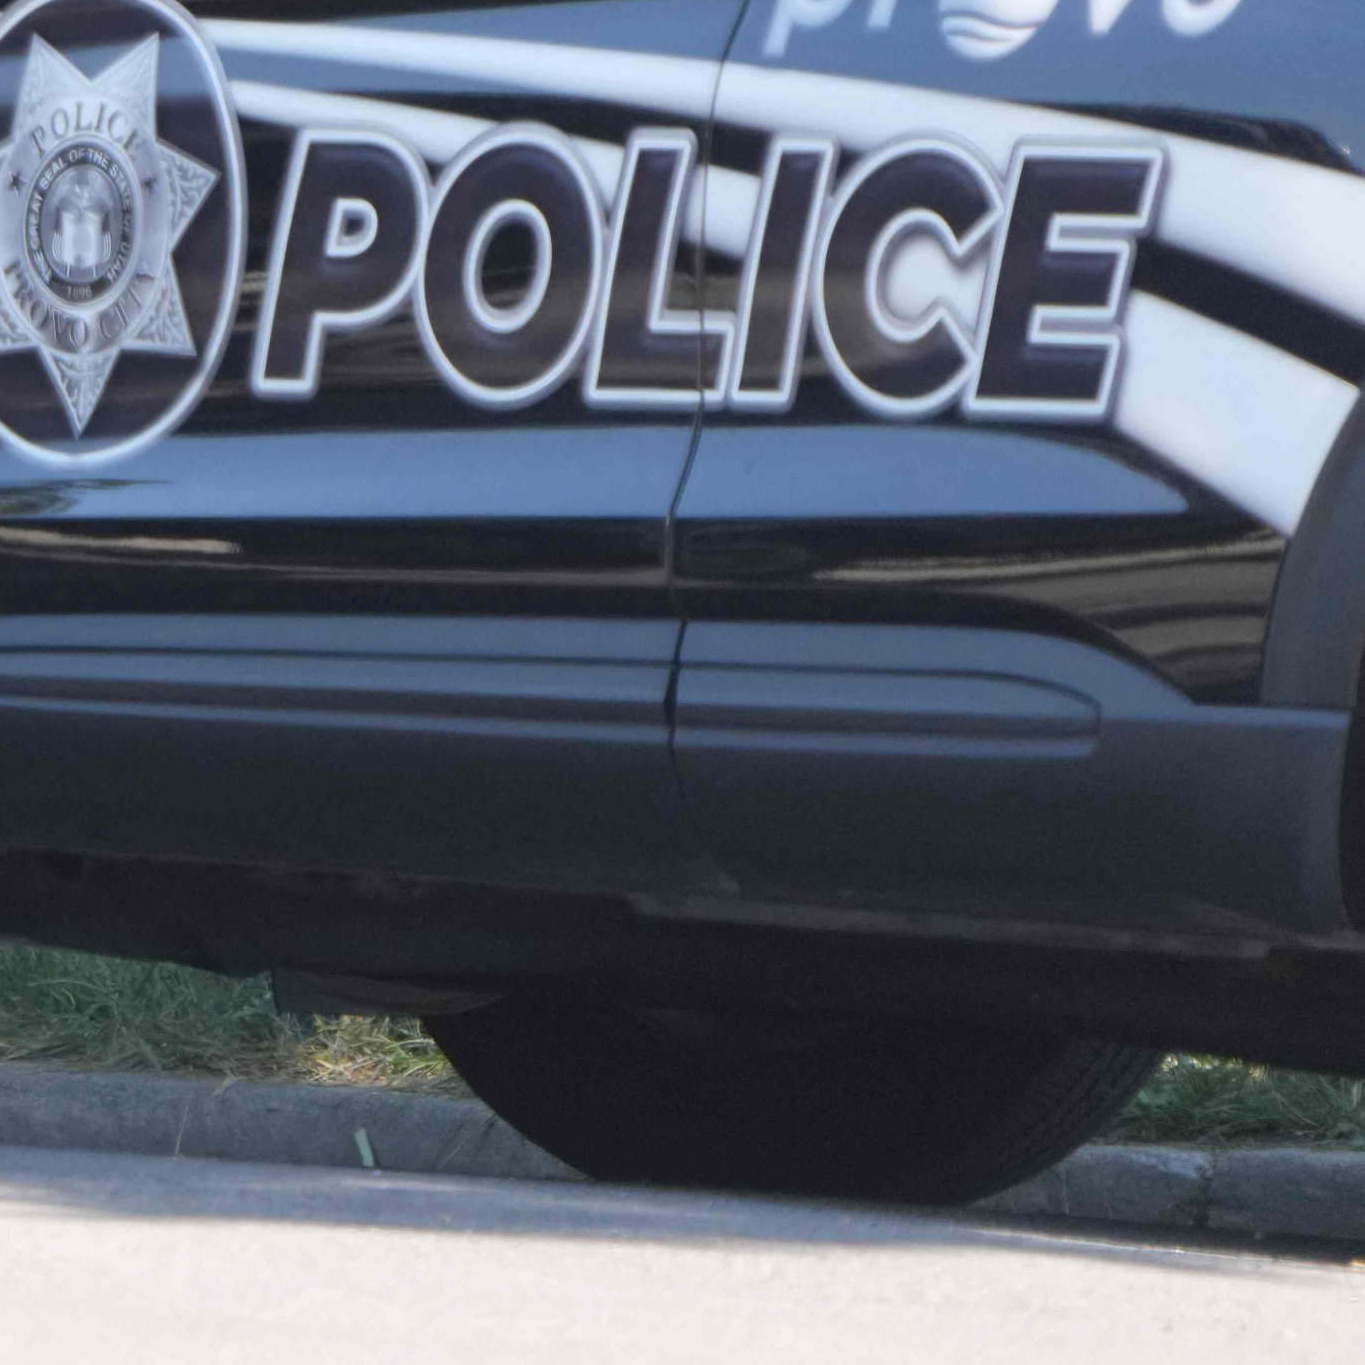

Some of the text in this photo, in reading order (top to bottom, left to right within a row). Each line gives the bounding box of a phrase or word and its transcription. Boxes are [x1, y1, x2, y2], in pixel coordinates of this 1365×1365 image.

[29, 100, 138, 159] POLICE
[39, 156, 67, 190] SEAL
[69, 148, 86, 164] OF
[88, 147, 111, 171] THE
[65, 285, 93, 300] 1896
[252, 124, 1166, 416] POLICE
